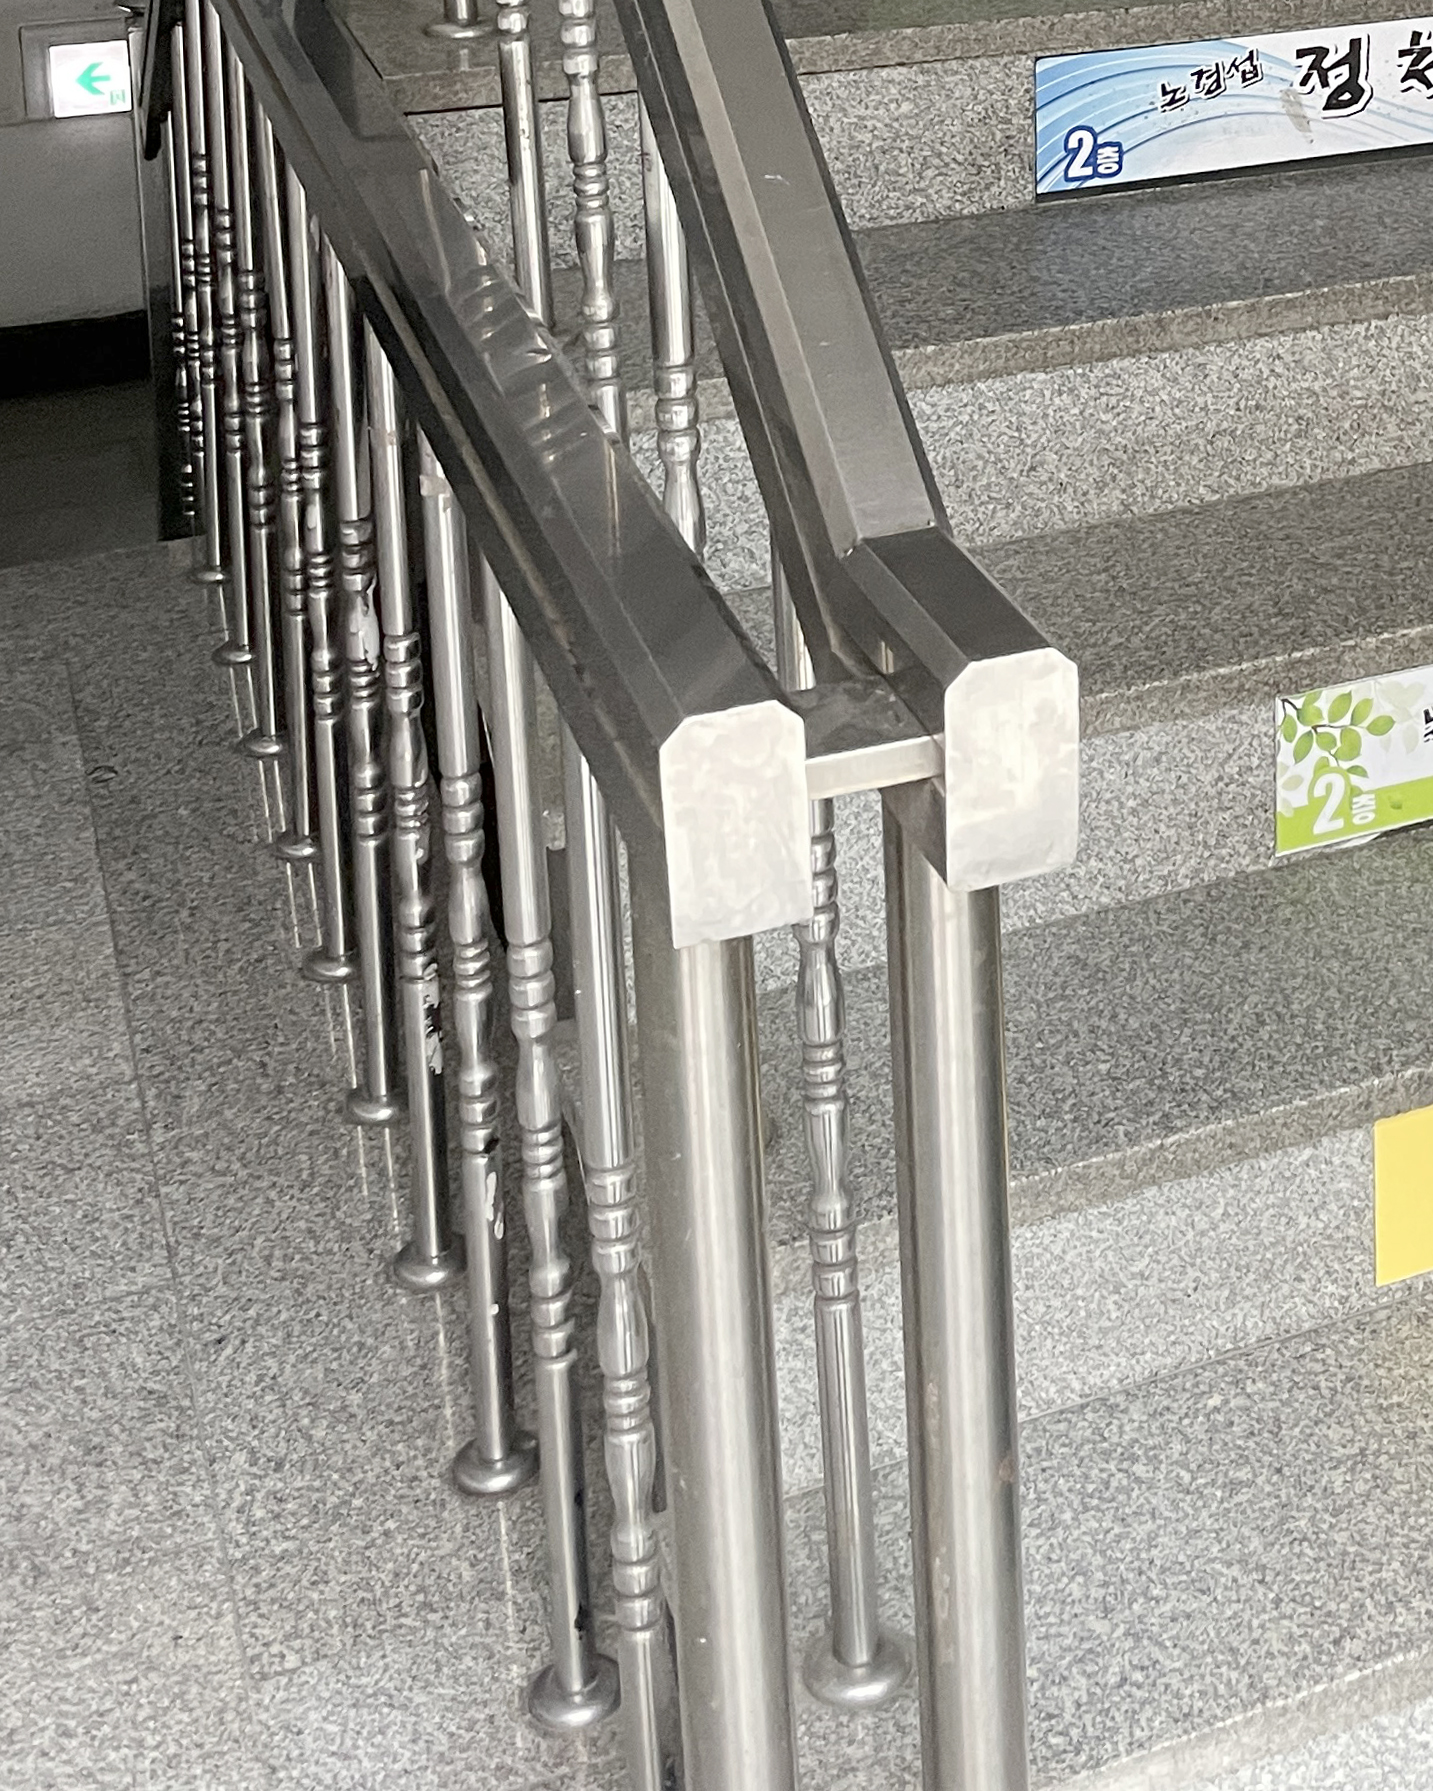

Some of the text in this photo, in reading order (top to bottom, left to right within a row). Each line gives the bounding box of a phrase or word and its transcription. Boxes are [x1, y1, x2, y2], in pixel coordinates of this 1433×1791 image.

[1157, 49, 1264, 112] 노경섭
[1062, 125, 1124, 183] 2층
[1310, 772, 1378, 837] 2층
